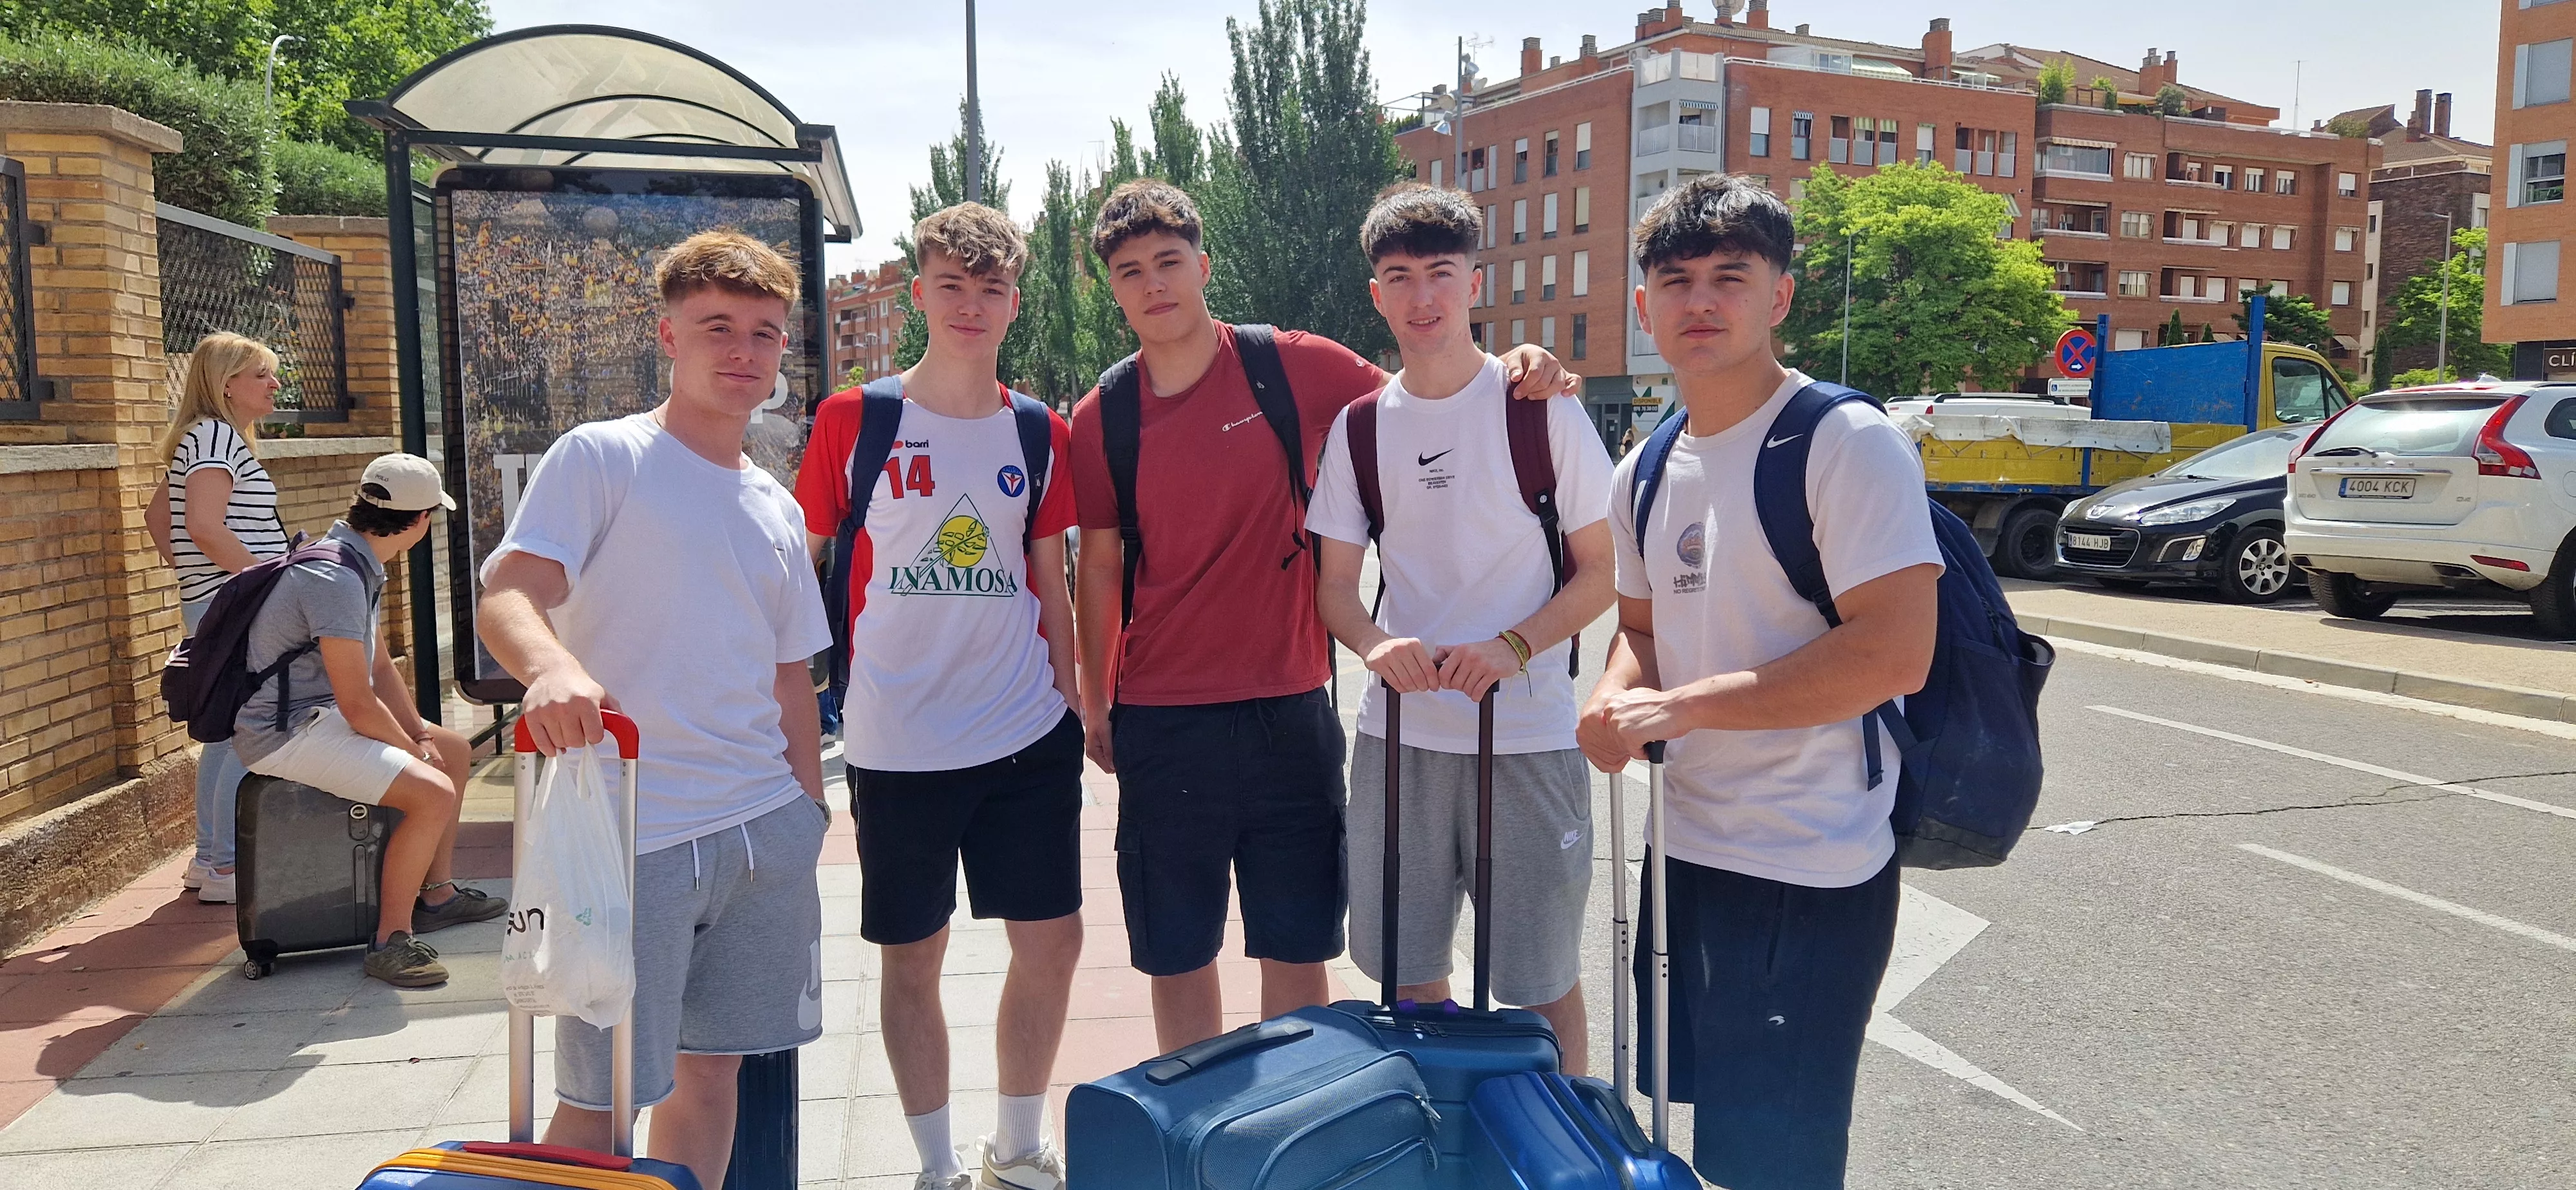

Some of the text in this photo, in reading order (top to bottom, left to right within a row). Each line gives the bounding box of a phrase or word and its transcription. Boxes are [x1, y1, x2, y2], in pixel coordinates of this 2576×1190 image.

[905, 440, 929, 448] barri
[882, 455, 936, 500] 14
[2349, 480, 2410, 493] 4004 KCK
[2073, 536, 2109, 549] 8144 HJB
[887, 566, 1018, 593] INAMOSA
[1564, 829, 1578, 842] NIKE
